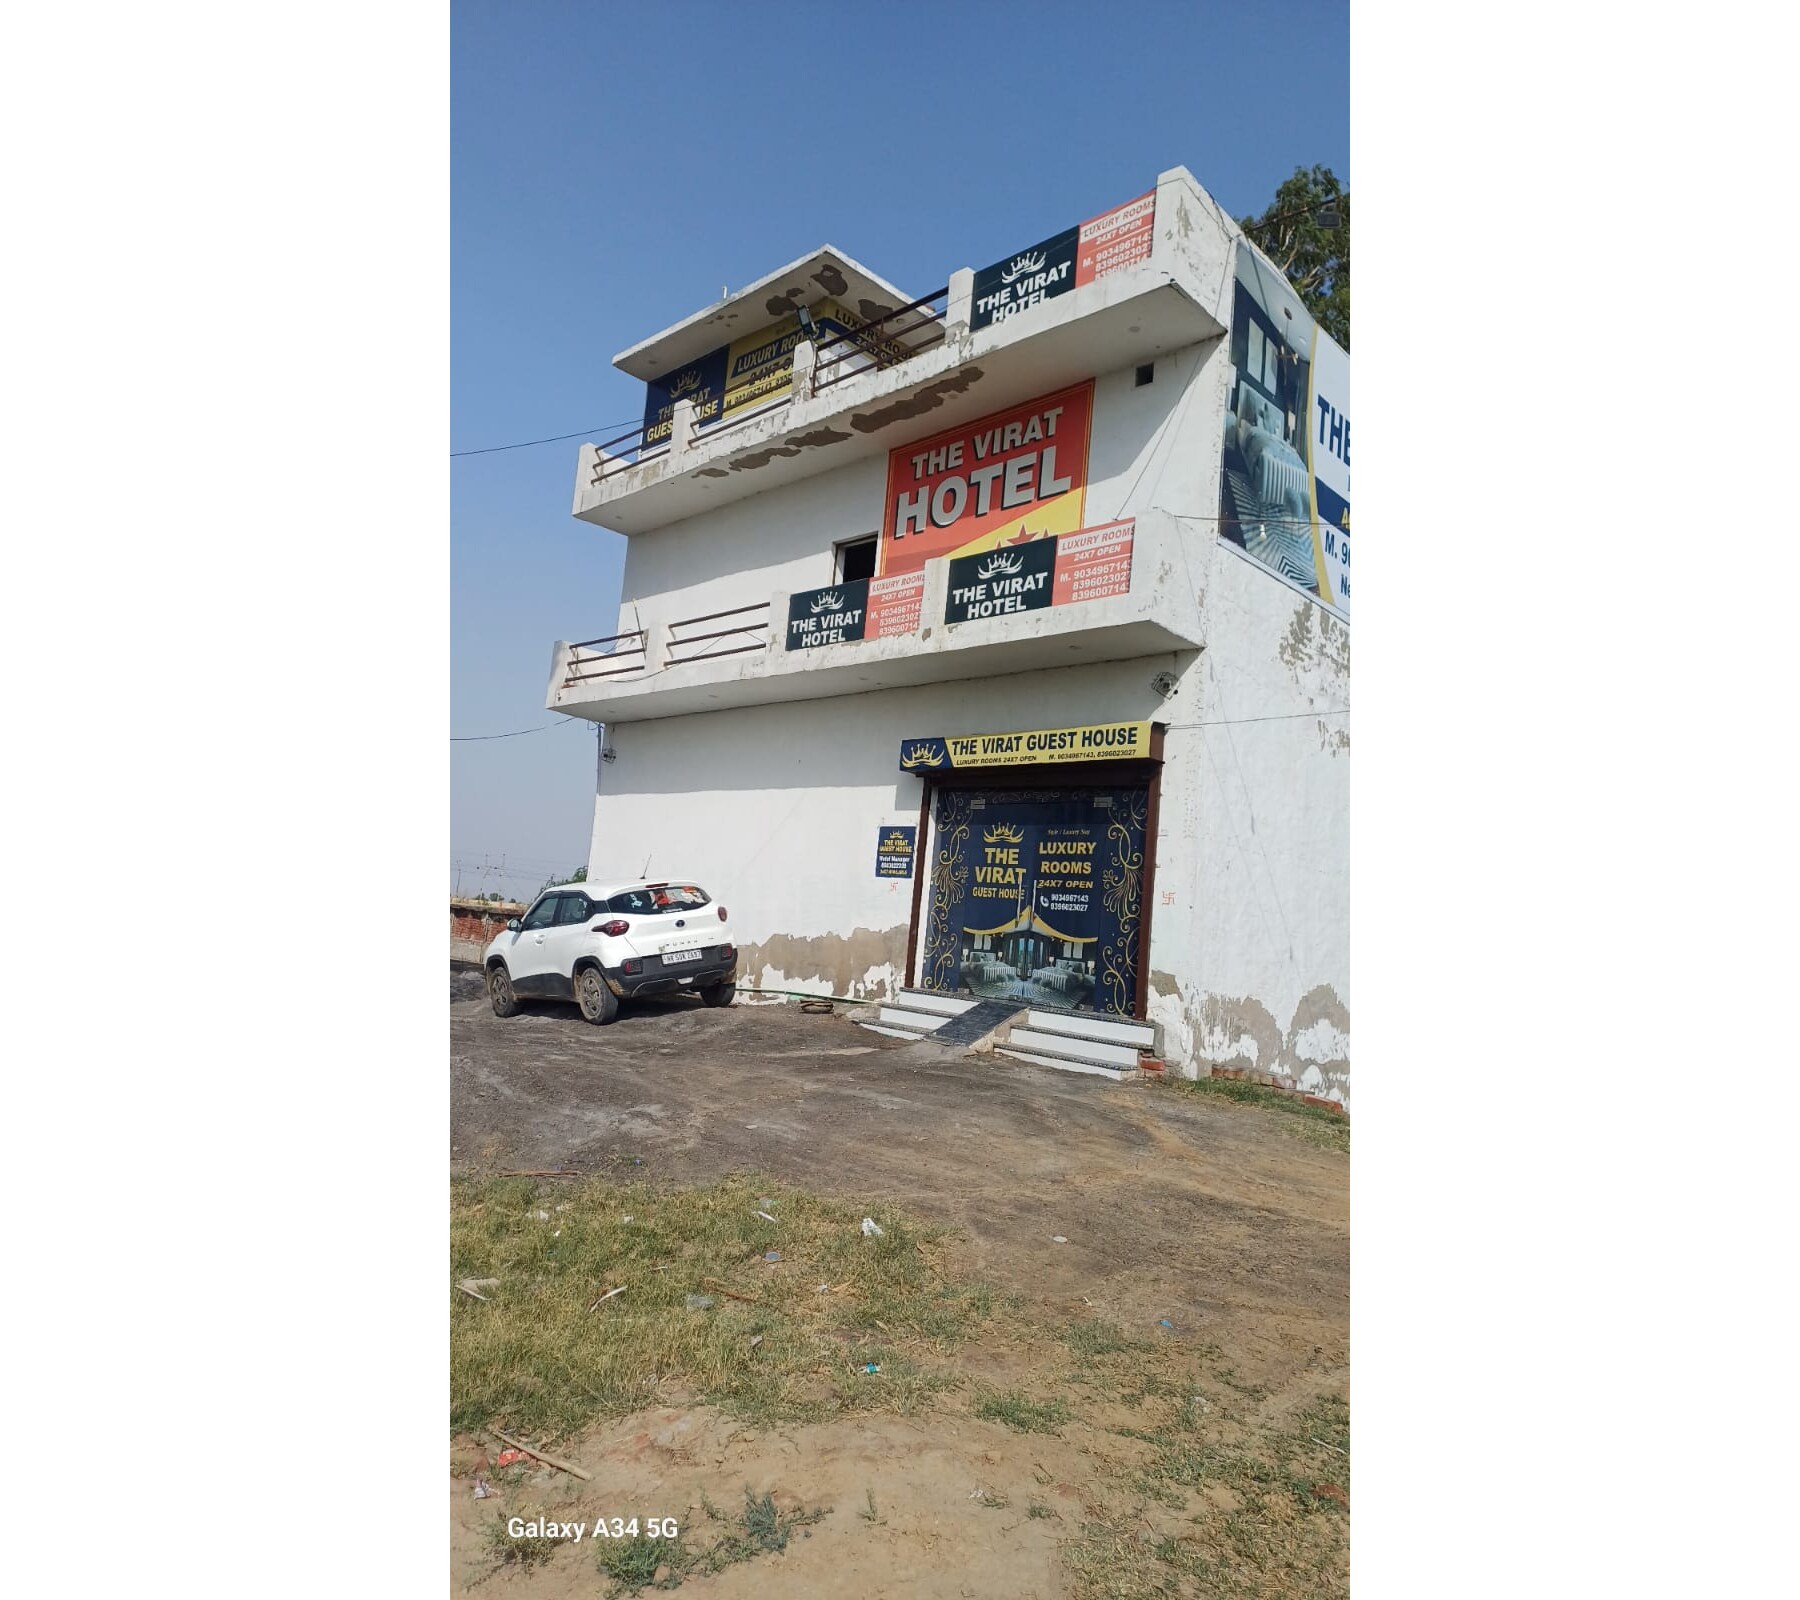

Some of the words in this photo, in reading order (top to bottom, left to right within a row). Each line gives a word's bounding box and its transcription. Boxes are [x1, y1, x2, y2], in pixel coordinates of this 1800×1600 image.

[1083, 216, 1120, 238] LUXURY
[977, 287, 1012, 314] THE
[1016, 260, 1071, 297] VIRAT
[991, 288, 1051, 325] HOTEL
[736, 341, 780, 373] LUXURY
[646, 419, 674, 443] GUES
[911, 440, 965, 480] THE
[973, 406, 1064, 461] VIRAT
[894, 445, 1072, 540] HOTEL
[1062, 534, 1100, 551] LUXURY
[1073, 549, 1096, 562] 24X7
[1097, 543, 1121, 556] OPEN
[1325, 529, 1338, 559] M.
[872, 579, 900, 593] LUXURY
[952, 584, 987, 605] THE
[992, 571, 1048, 597] VIRAT
[1060, 572, 1072, 583] M.
[967, 594, 1027, 620] HOTEL
[791, 617, 818, 634] THE
[820, 609, 862, 630] VIRAT
[801, 628, 846, 648] HOTEL
[951, 738, 978, 756] THE
[981, 735, 1023, 755] VIRAT
[1026, 731, 1078, 752] GUEST
[1081, 726, 1139, 748] HOUSE
[956, 758, 980, 766] LUXURY
[984, 847, 1020, 865] THE
[1039, 841, 1098, 855] LUXURY
[974, 866, 1027, 885] VIRAT
[1040, 861, 1092, 875] ROOMS
[972, 886, 998, 898] GUEST
[998, 887, 1025, 900] HOUSE
[1037, 879, 1063, 889] 24X7
[1065, 880, 1094, 889] OPEN
